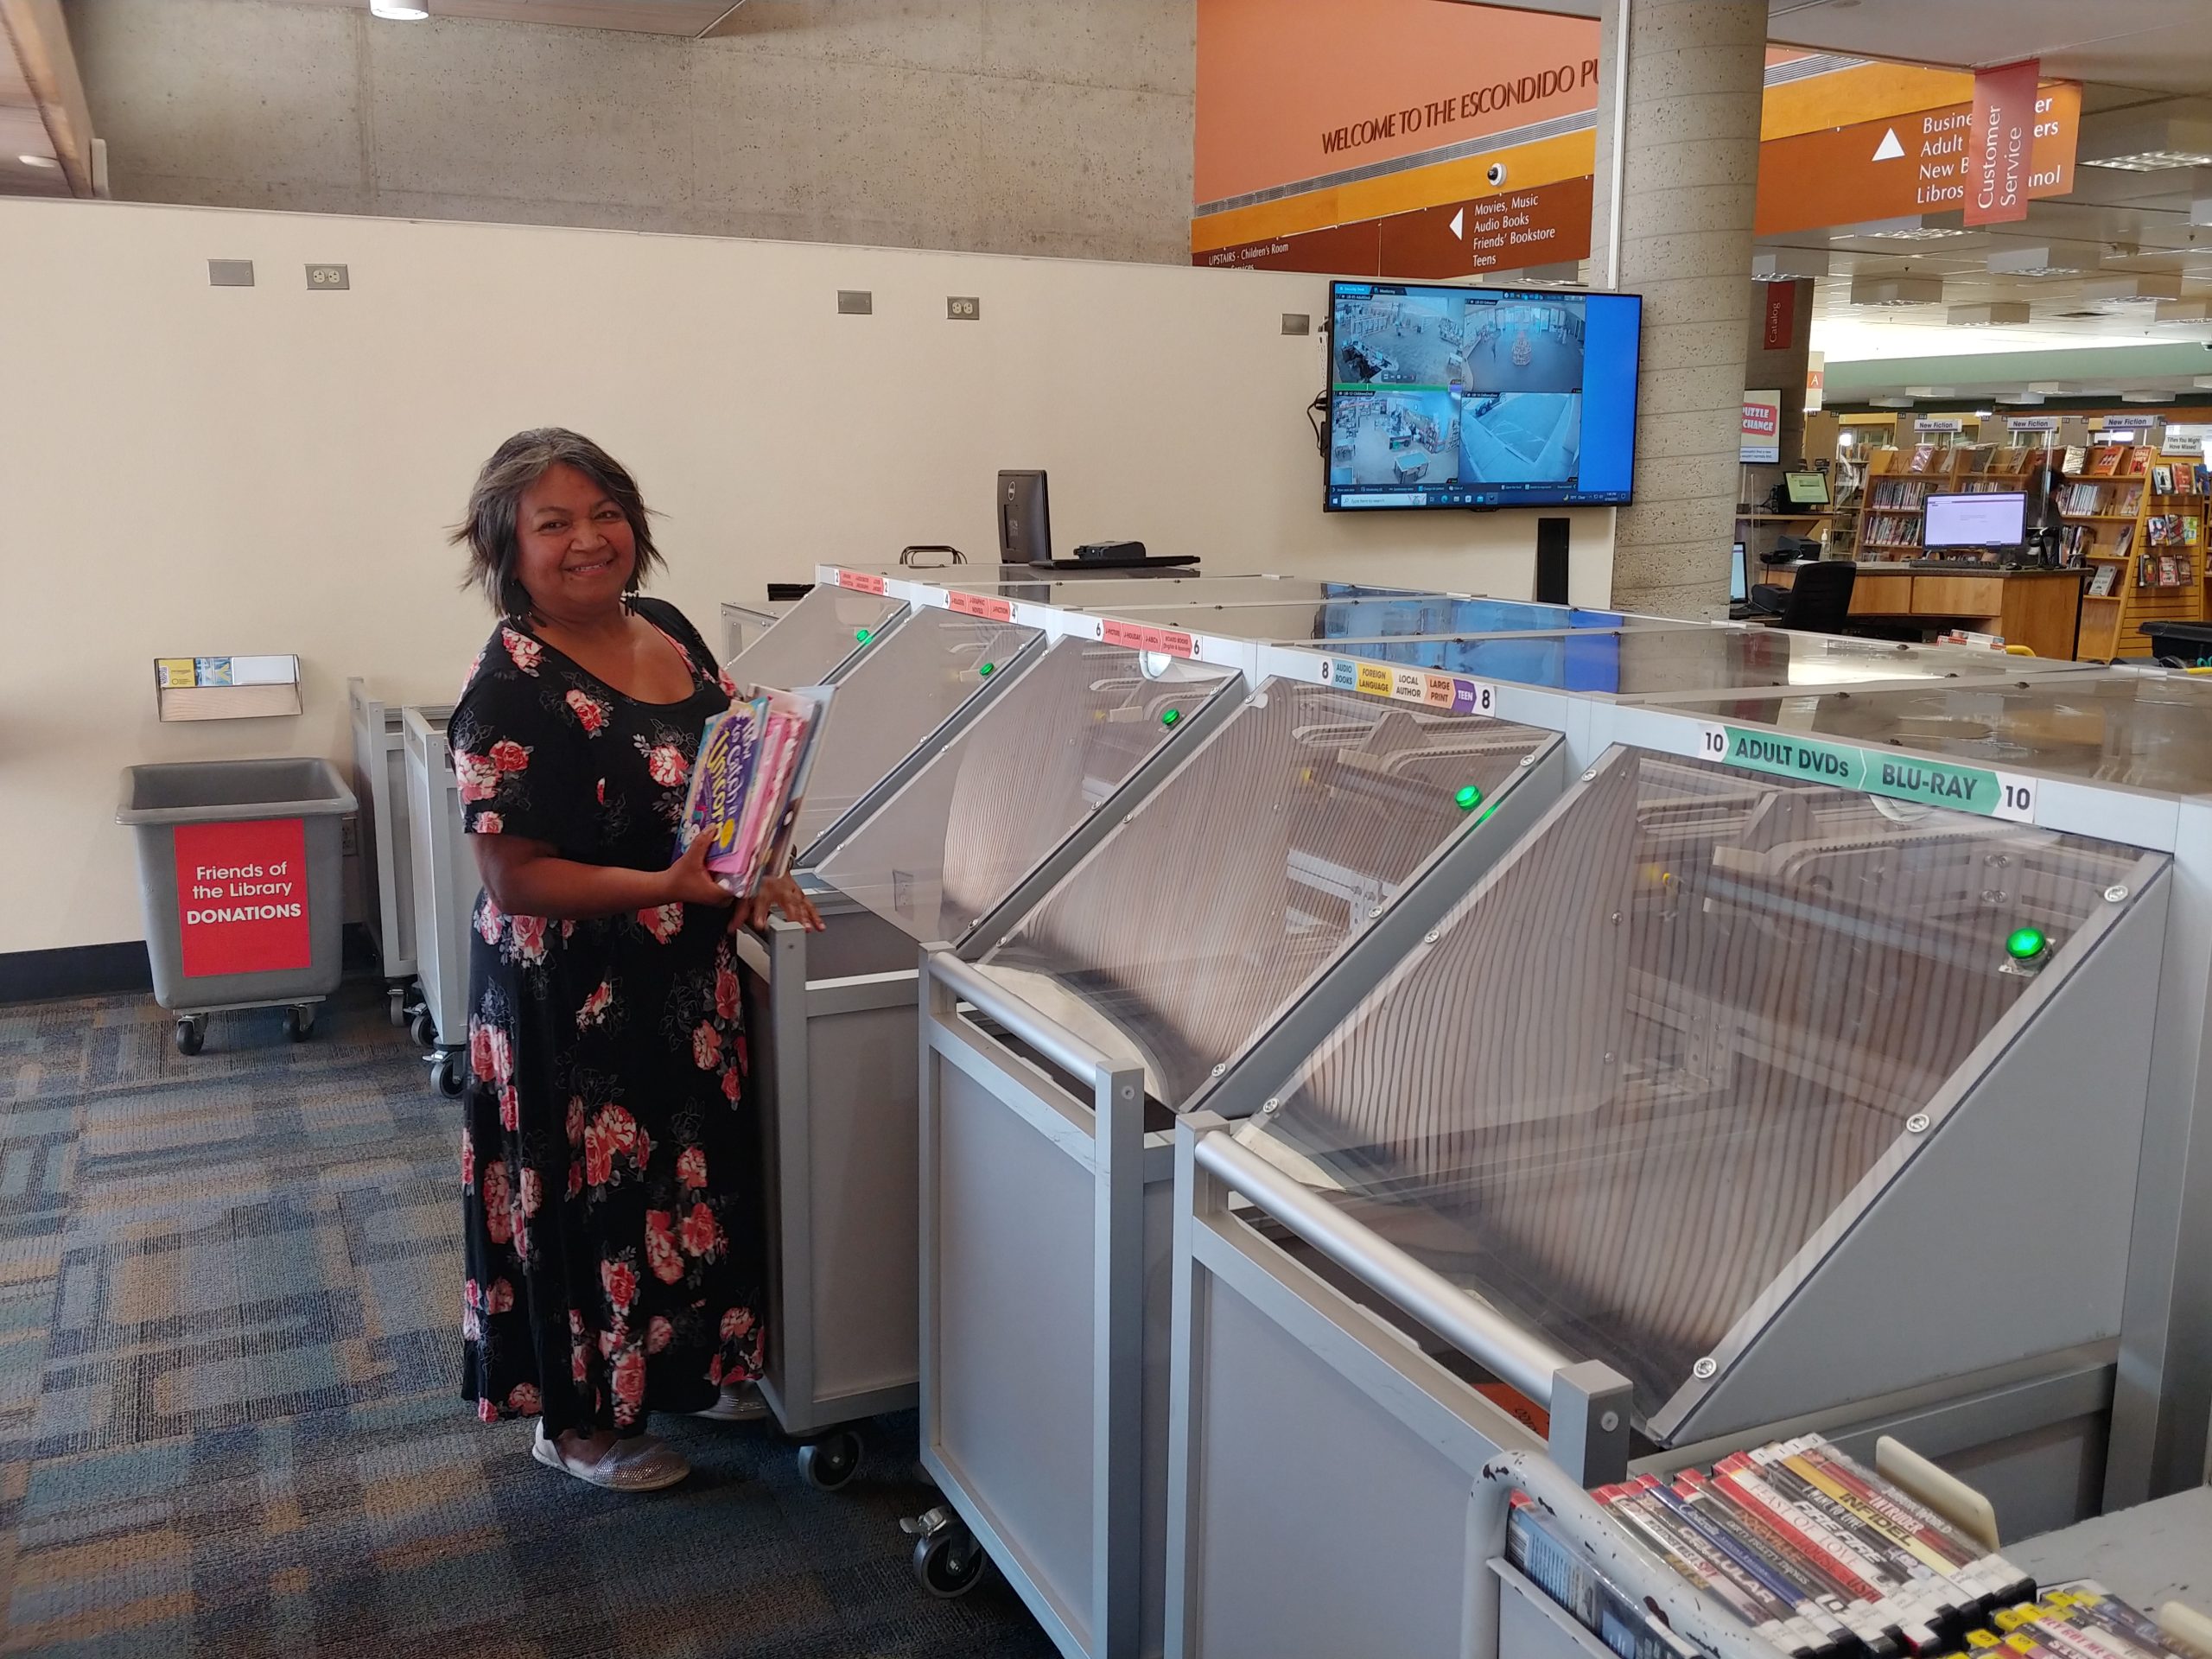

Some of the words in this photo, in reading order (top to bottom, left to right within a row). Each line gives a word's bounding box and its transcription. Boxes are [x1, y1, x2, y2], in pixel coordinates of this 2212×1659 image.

[1322, 114, 1395, 154] WELCOME
[1399, 108, 1421, 134] TO
[1425, 98, 1456, 128] THE
[1460, 66, 1575, 118] ESCONDIDO
[2035, 97, 2053, 114] er
[1920, 134, 1963, 157] Adult
[2033, 121, 2059, 138] ers
[1919, 163, 1955, 181] New
[1961, 157, 1969, 174] B
[1978, 105, 2001, 209] Customer
[2000, 127, 2022, 207] Service
[1916, 185, 1964, 204] Libros
[2028, 164, 2062, 188] nol
[1474, 200, 1508, 217] Movies,
[1510, 194, 1539, 210] Music
[1473, 218, 1500, 233] Audio
[1502, 212, 1529, 228] Books
[1473, 232, 1508, 251] Friends'
[1510, 227, 1555, 245] Bookstore
[1209, 251, 1236, 266] UPSTAIRS
[1241, 245, 1270, 260] Children's
[1271, 243, 1289, 255] Room
[1472, 254, 1497, 268] Teens
[1769, 302, 1781, 344] Catalog
[1811, 374, 1819, 386] A
[1742, 419, 1774, 432] CHANGE
[835, 572, 839, 583] 2
[884, 582, 888, 593] 2
[1011, 607, 1016, 620] 4
[1096, 622, 1102, 637] 6
[1193, 639, 1200, 655] 6
[1321, 661, 1329, 679] 8
[1336, 664, 1352, 674] AUDIO
[1362, 668, 1387, 680] FOREIGN
[1398, 674, 1419, 686] LOCAL
[1429, 679, 1450, 690] LARGE
[1457, 690, 1473, 702] TEEN
[1482, 690, 1491, 709] 8
[1335, 676, 1353, 686] BOOKS
[1358, 679, 1389, 692] LANGUAGE
[1395, 686, 1421, 698] AUTHOR
[1430, 692, 1449, 702] PRINT
[726, 744, 744, 808] Catch
[1705, 733, 1724, 753] 10
[1735, 737, 1793, 767] ADULT
[1798, 750, 1849, 778] DVDs
[1882, 763, 1979, 801] BLU-RAY
[2005, 785, 2031, 810] 10
[196, 863, 264, 880] Friends
[269, 861, 288, 876] of
[193, 885, 224, 899] the
[230, 881, 293, 897] Library
[187, 903, 302, 925] DONATIONS
[1751, 1484, 1791, 1513] FEAST
[1794, 1516, 1816, 1533] OF
[1821, 1534, 1859, 1568] LOVE
[1839, 1492, 1911, 1547] INFIDEL
[1868, 1494, 1925, 1534] INTRUDER
[1677, 1526, 1777, 1603] CELLULAR
